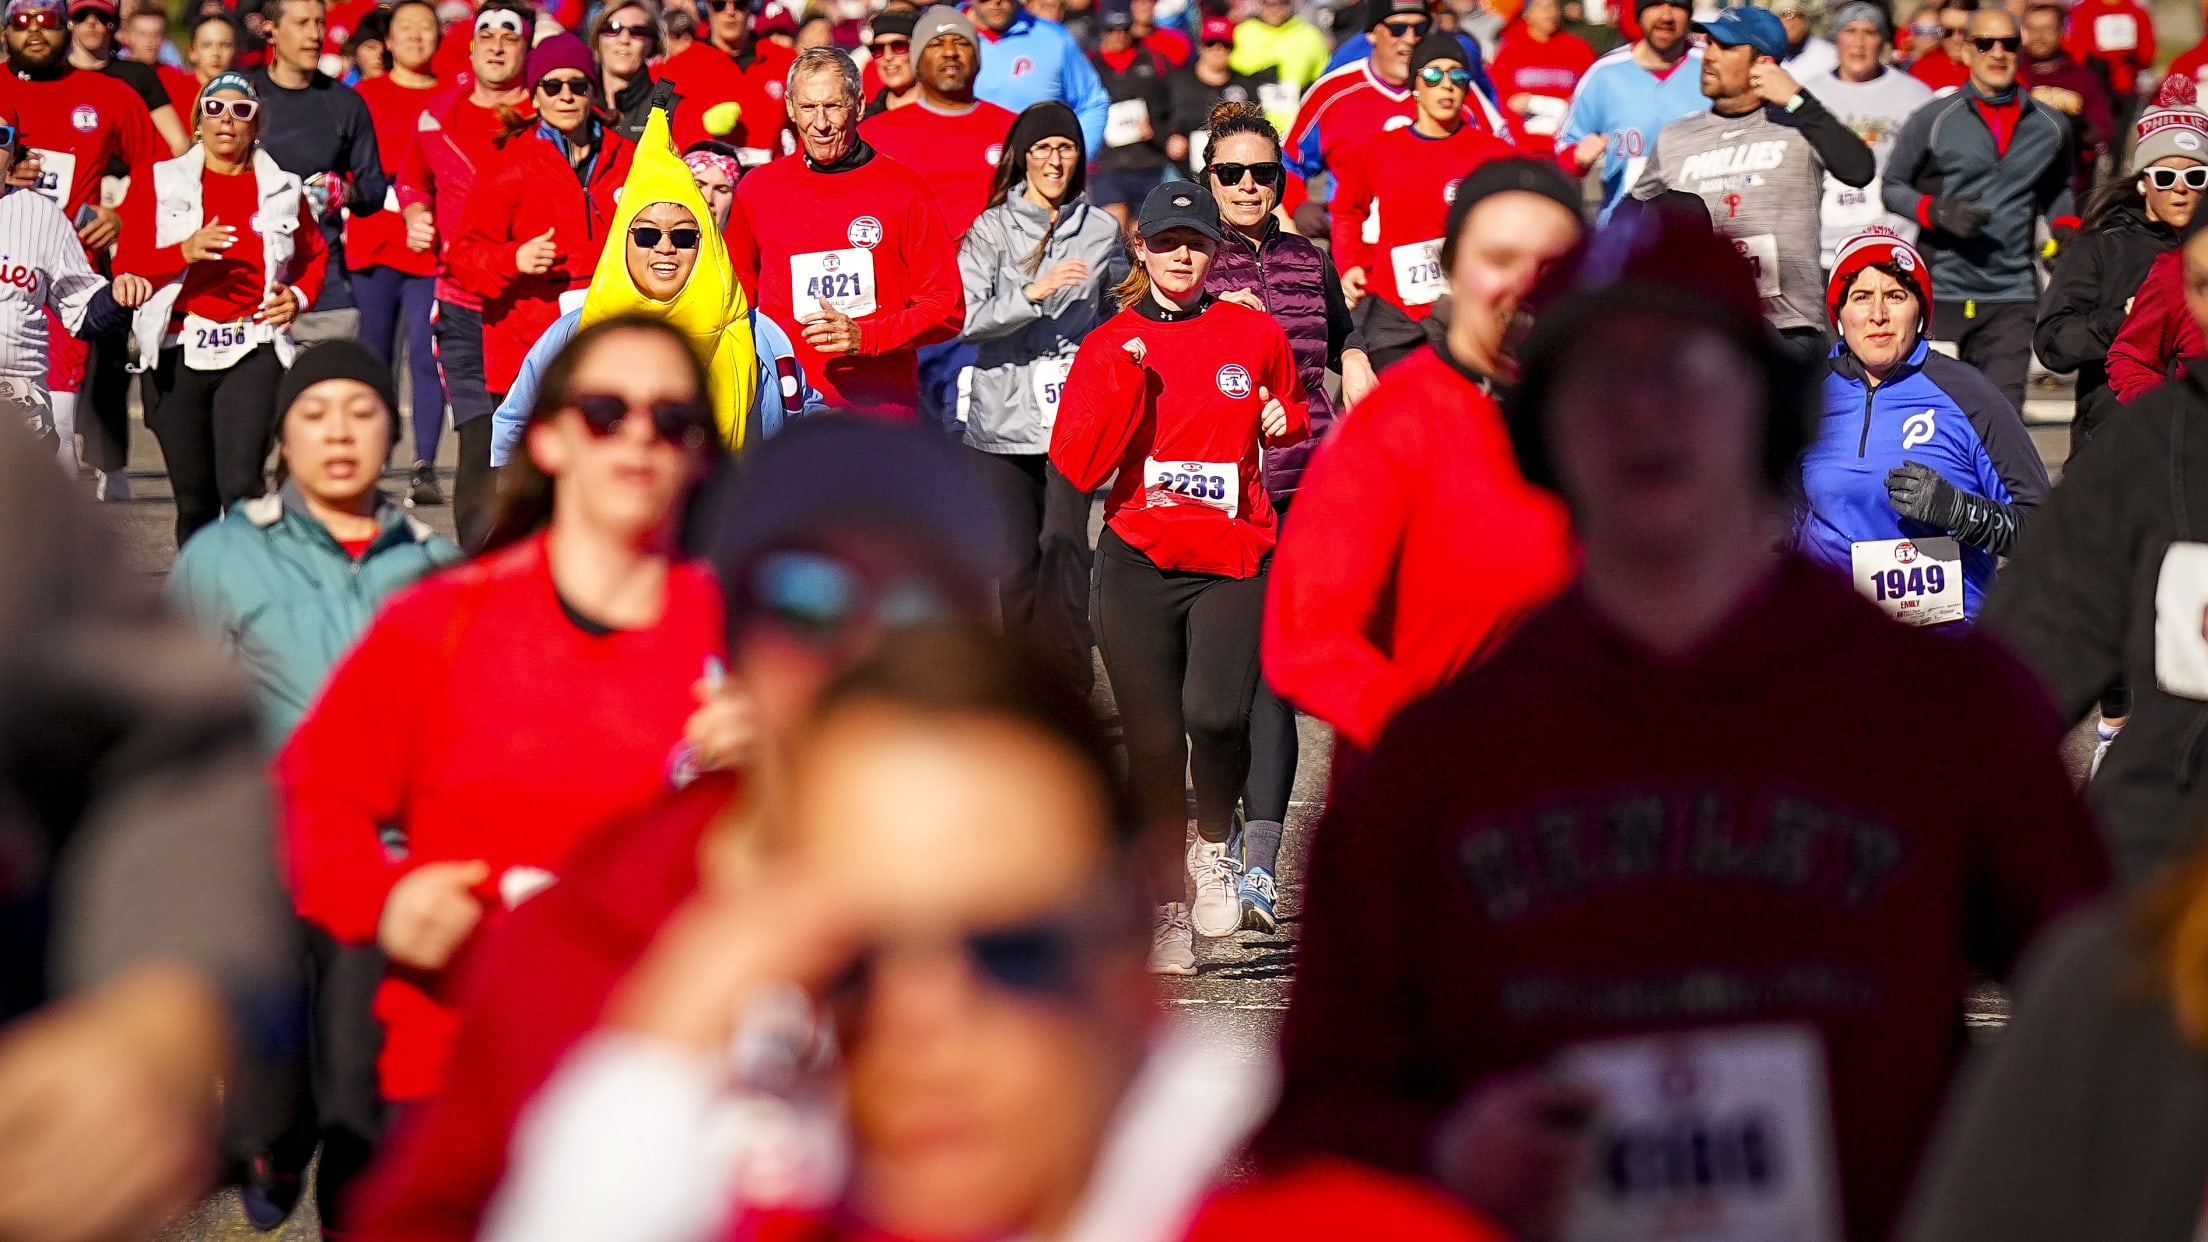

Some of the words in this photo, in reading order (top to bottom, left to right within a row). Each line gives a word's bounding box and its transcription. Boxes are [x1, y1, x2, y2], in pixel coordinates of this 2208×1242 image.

[1679, 140, 1788, 186] PHILLIES
[807, 273, 861, 299] 4821
[1220, 372, 1250, 392] 5K
[1158, 471, 1225, 500] 2233
[1871, 565, 1945, 601] 1949
[1901, 600, 1920, 609] EMILY
